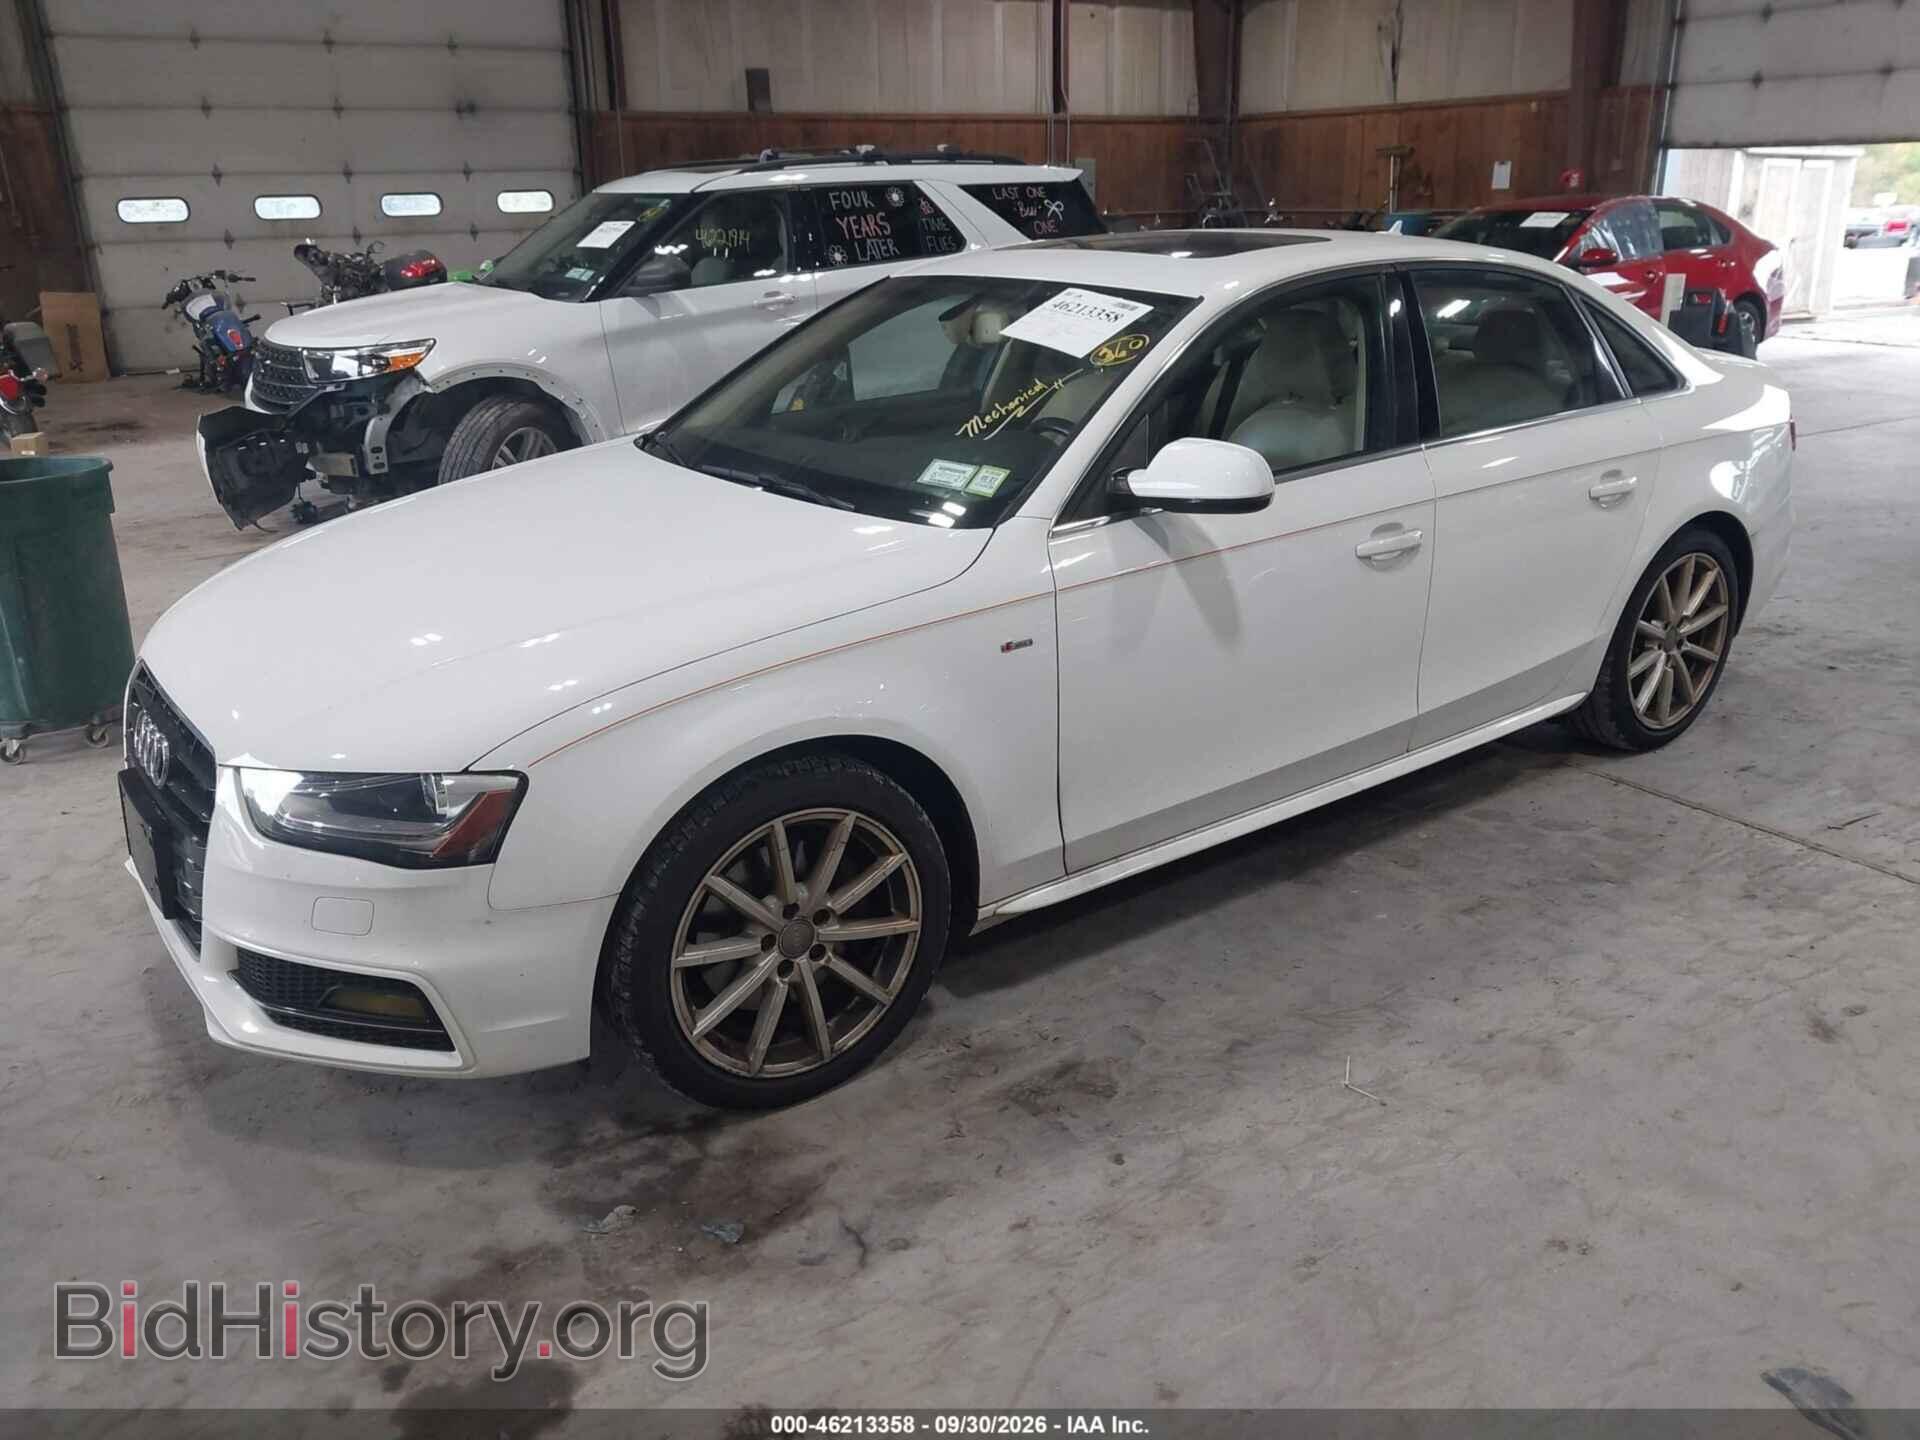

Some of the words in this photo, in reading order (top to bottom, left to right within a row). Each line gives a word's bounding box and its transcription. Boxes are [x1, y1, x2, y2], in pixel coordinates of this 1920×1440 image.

[829, 191, 876, 210] FOUR
[991, 186, 1019, 201] LAST
[1025, 185, 1048, 198] ONE
[836, 211, 892, 241] YEARS
[920, 217, 951, 232] TIME
[1033, 219, 1059, 235] ONE
[854, 238, 900, 262] LATER
[926, 235, 958, 253] FLIES
[1053, 300, 1125, 323] 46213358
[955, 377, 1048, 438] Mechanical
